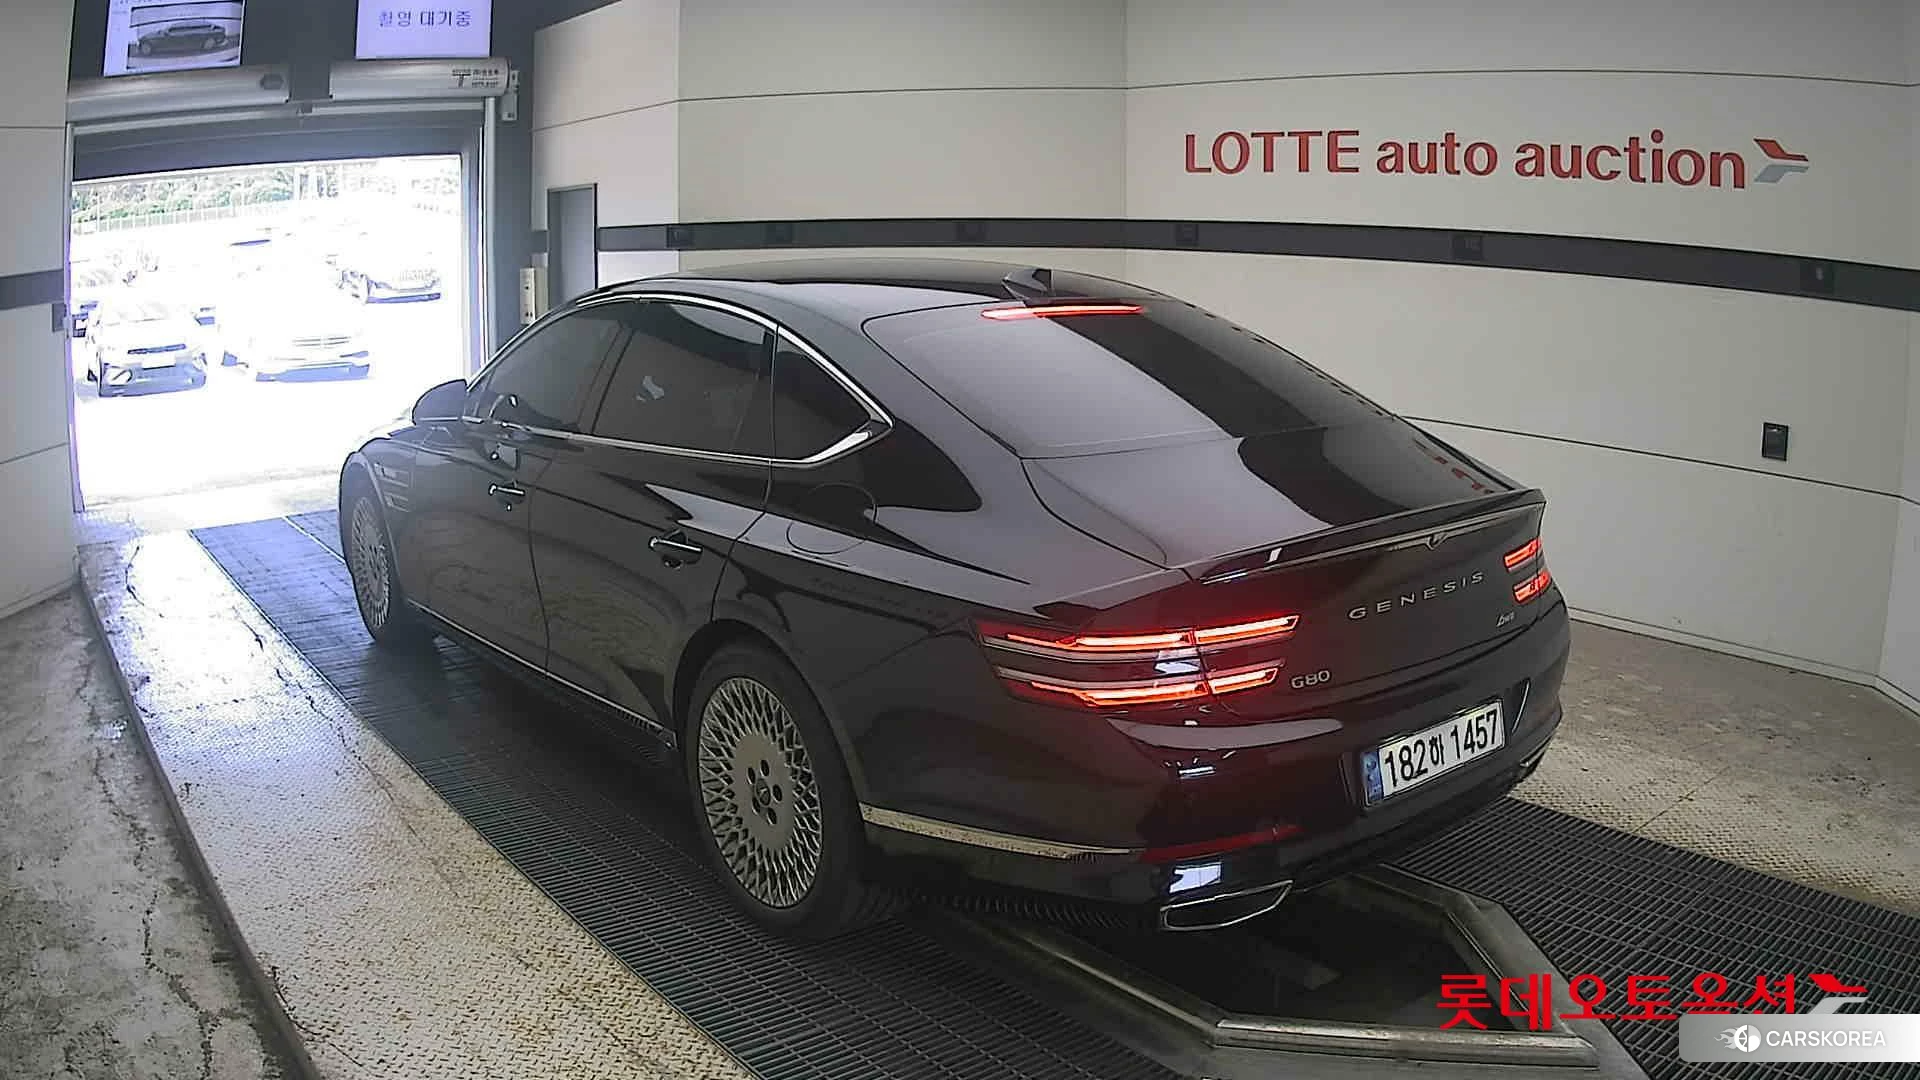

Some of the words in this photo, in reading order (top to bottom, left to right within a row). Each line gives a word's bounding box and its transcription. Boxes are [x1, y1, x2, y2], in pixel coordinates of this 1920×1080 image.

[420, 10, 472, 27] 대기중
[1185, 130, 1360, 174] LOTTE
[1376, 132, 1499, 176] auto
[1514, 129, 1746, 188] auction
[1348, 570, 1484, 620] GENESIS
[1291, 669, 1331, 689] G80
[1384, 733, 1446, 788] 182하
[1450, 708, 1498, 761] 1457
